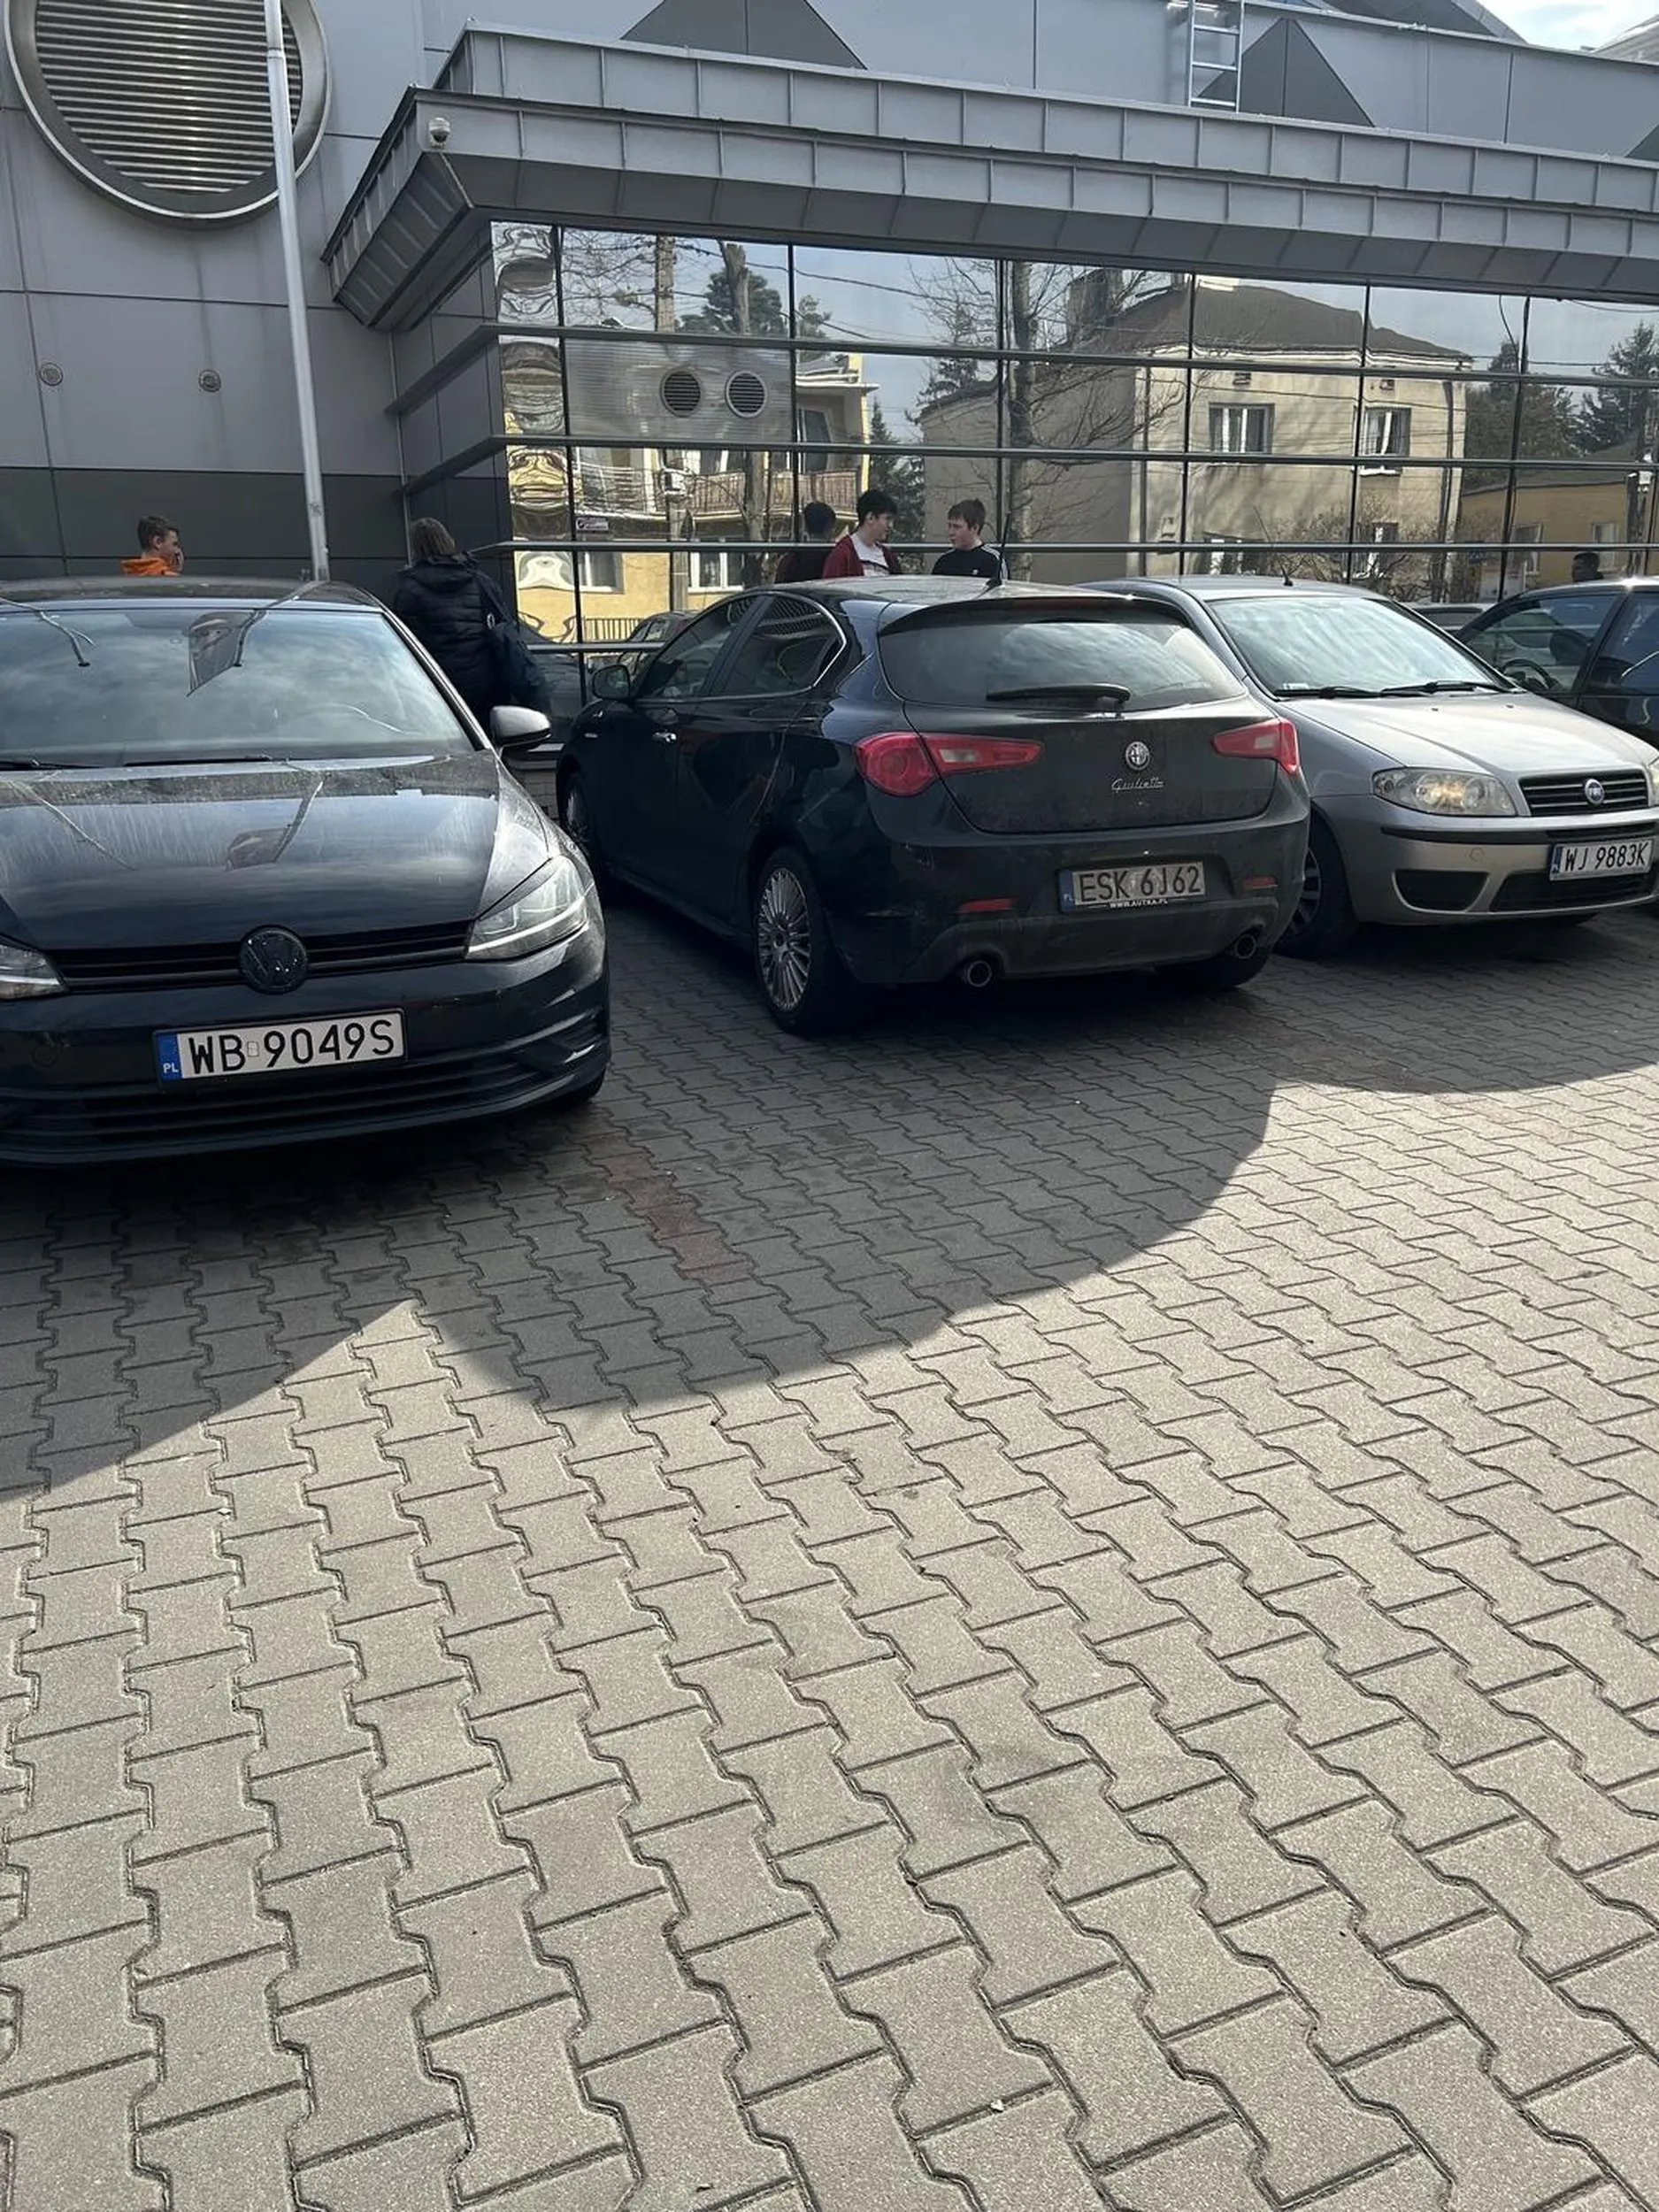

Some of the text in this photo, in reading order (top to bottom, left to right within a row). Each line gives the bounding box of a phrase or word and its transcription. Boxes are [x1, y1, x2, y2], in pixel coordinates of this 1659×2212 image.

[1564, 841, 1649, 872] WJ 9883K
[1079, 870, 1131, 902] ESK
[1140, 865, 1202, 896] 6J62
[163, 1018, 395, 1075] PL WB 9049S
